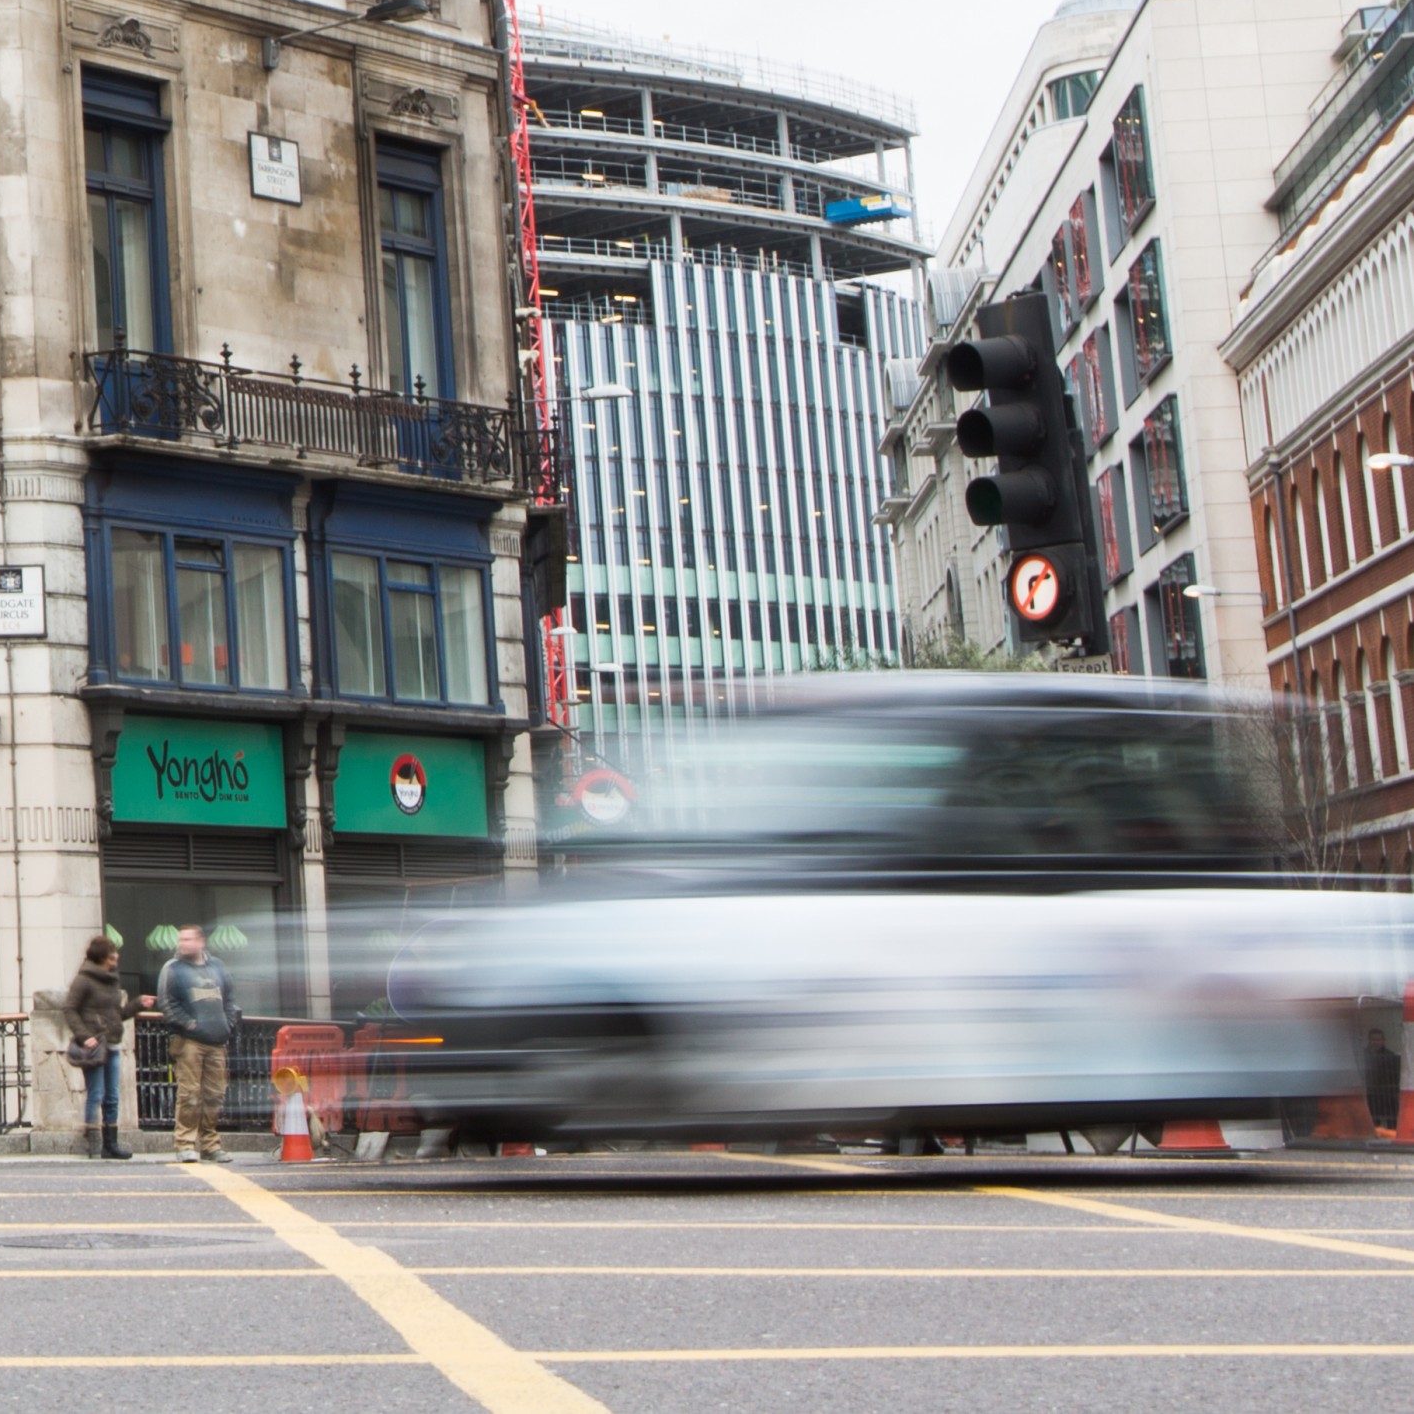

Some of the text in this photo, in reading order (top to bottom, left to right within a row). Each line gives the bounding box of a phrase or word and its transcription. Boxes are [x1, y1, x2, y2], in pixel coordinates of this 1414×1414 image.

[146, 739, 249, 803] Yonghó
[174, 791, 200, 801] BENTO
[219, 793, 249, 802] DIM SUM
